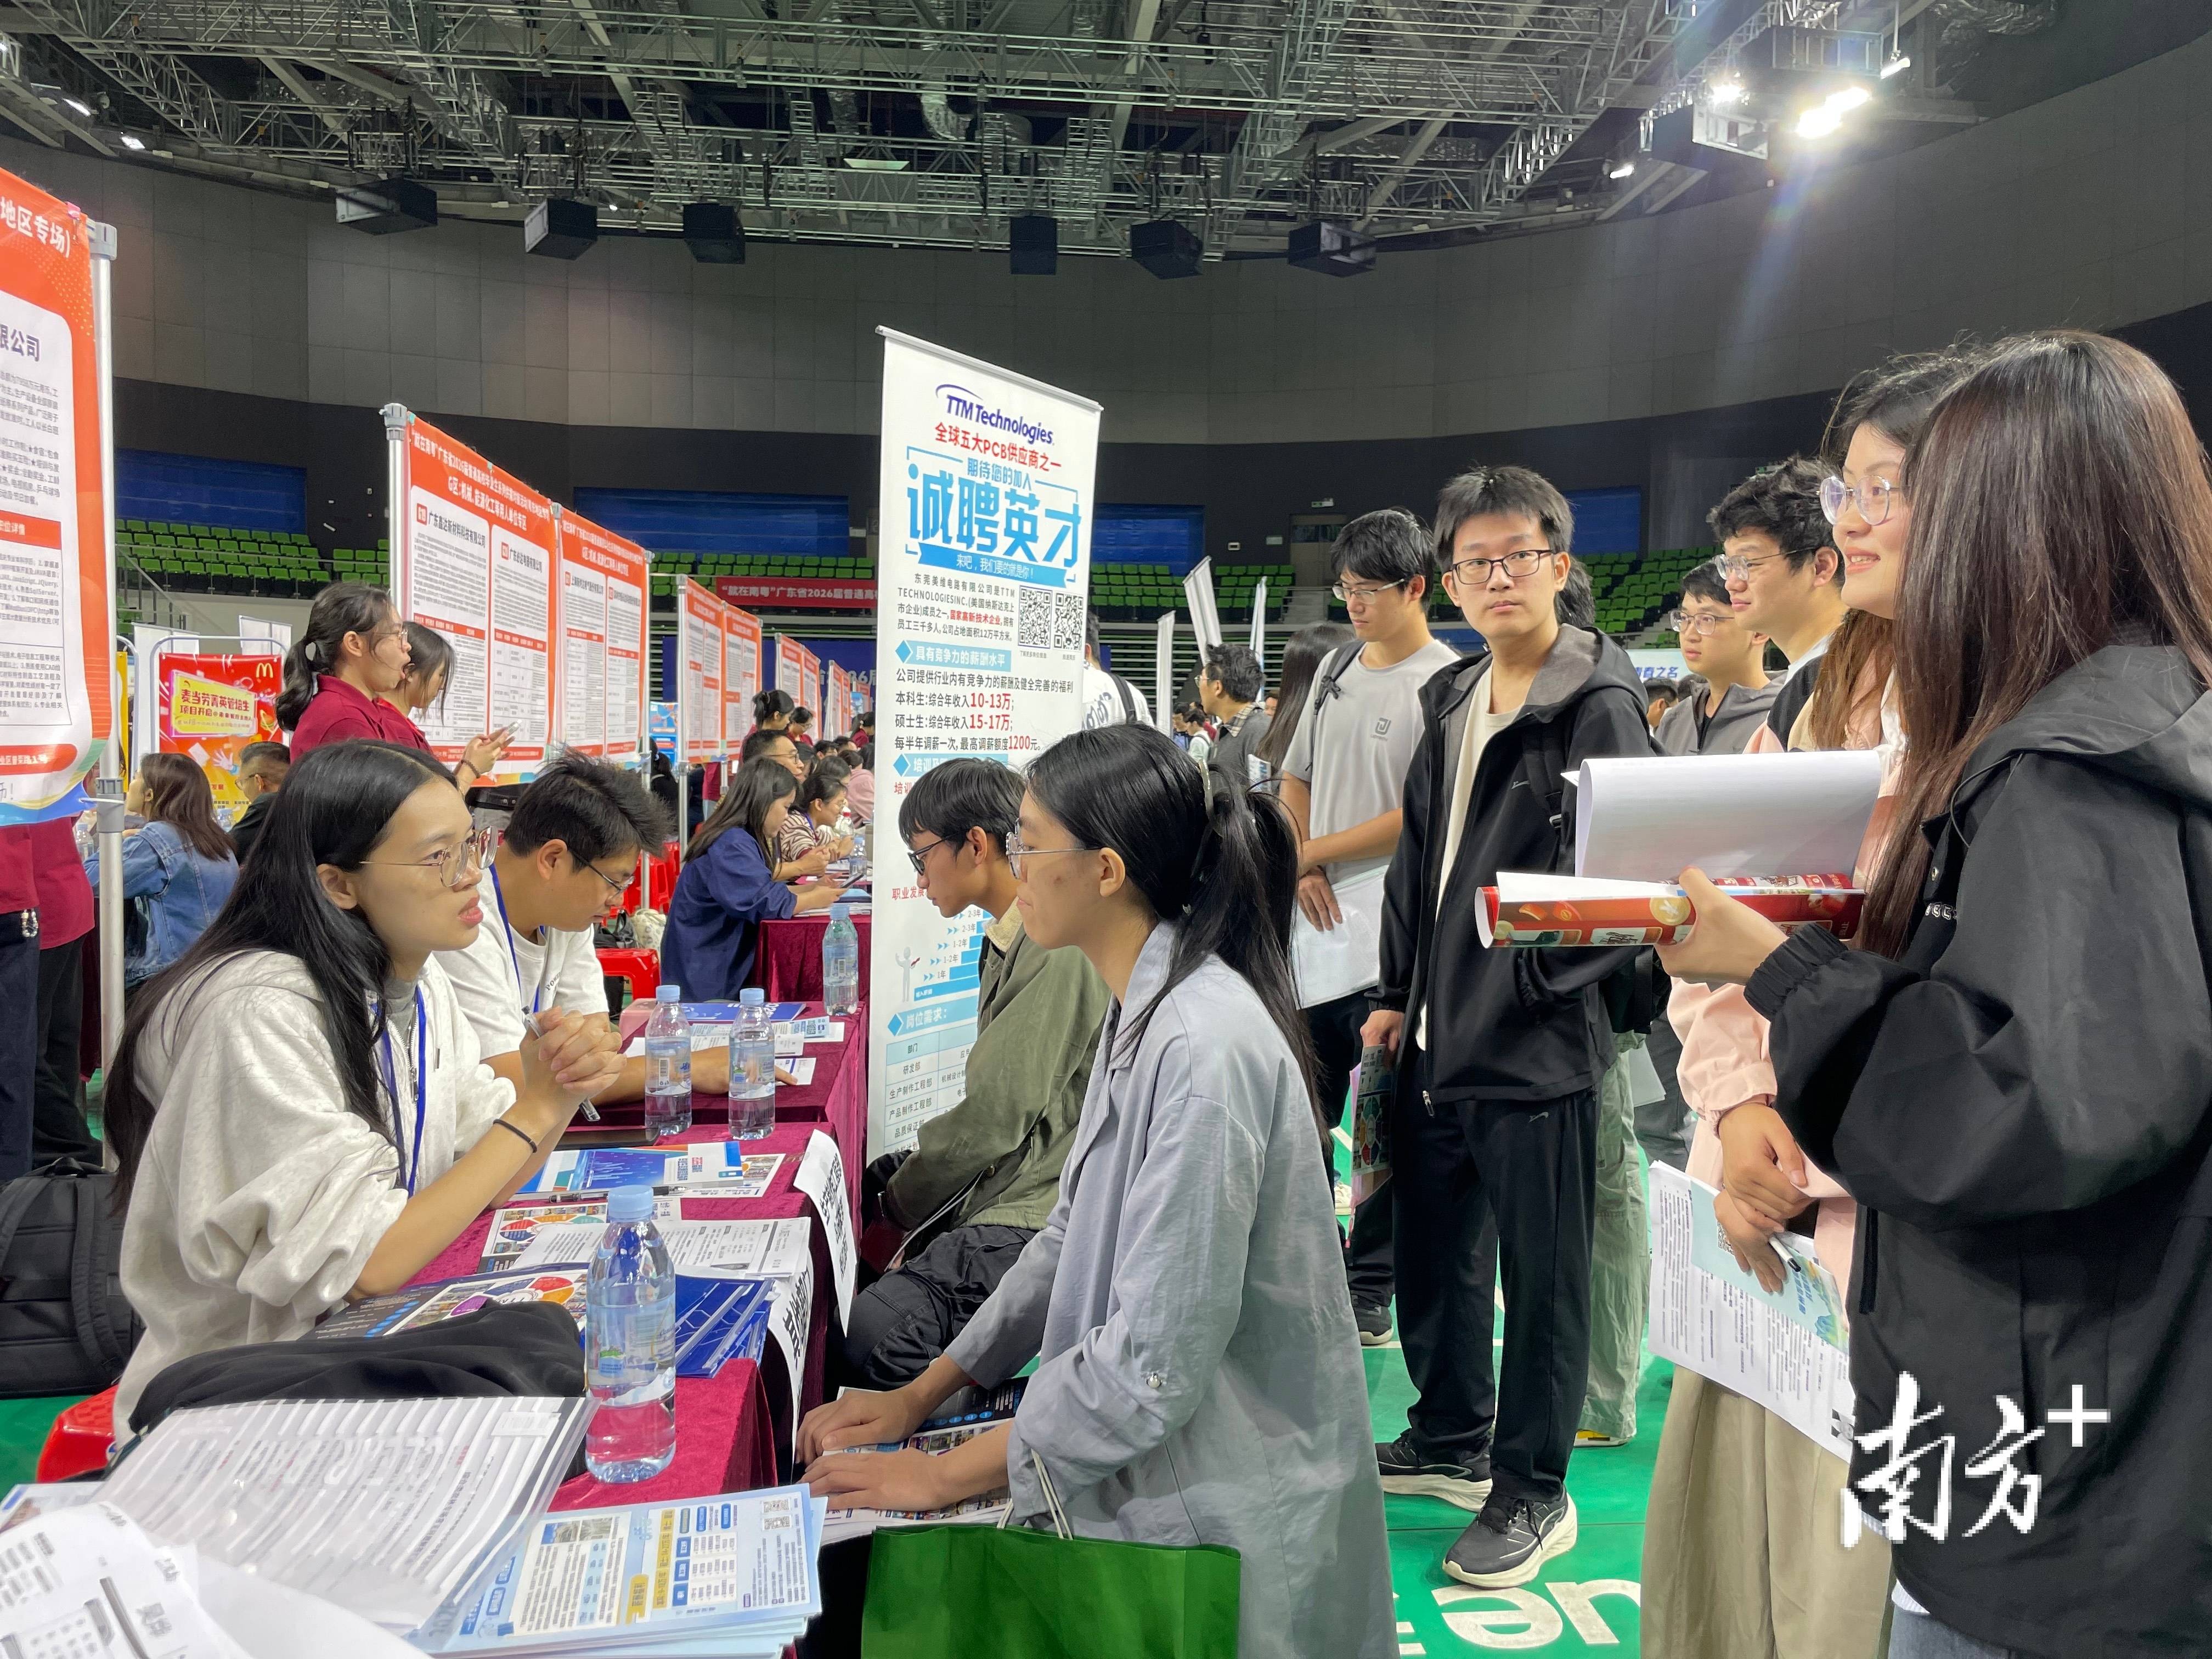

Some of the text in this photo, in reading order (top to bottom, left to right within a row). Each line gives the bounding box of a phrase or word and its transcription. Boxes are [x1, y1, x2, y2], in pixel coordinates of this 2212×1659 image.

[946, 394, 1054, 445] TTM Technologies
[935, 423, 1062, 472] 全球五大PCB供应商之一
[967, 458, 1032, 491] 期待您的加入
[906, 464, 1082, 568] 诚聘英才
[915, 645, 1006, 665] 具有竞争力的薪酬水平
[896, 668, 1074, 693] 公司提供行业内有竞争力的薪酬及健全完善的福利
[181, 689, 250, 712] 麦当劳菁英管培生
[968, 909, 981, 918] 2-3年
[962, 923, 975, 933] 2-3年
[953, 939, 967, 948] 1-2年
[943, 953, 958, 963] 1-2年
[937, 970, 946, 979] 1年
[907, 1043, 918, 1054] 部门
[903, 1062, 921, 1075] 研发部
[890, 1077, 932, 1099] 生产制作工程部
[889, 1098, 932, 1120] 产品制作工程部
